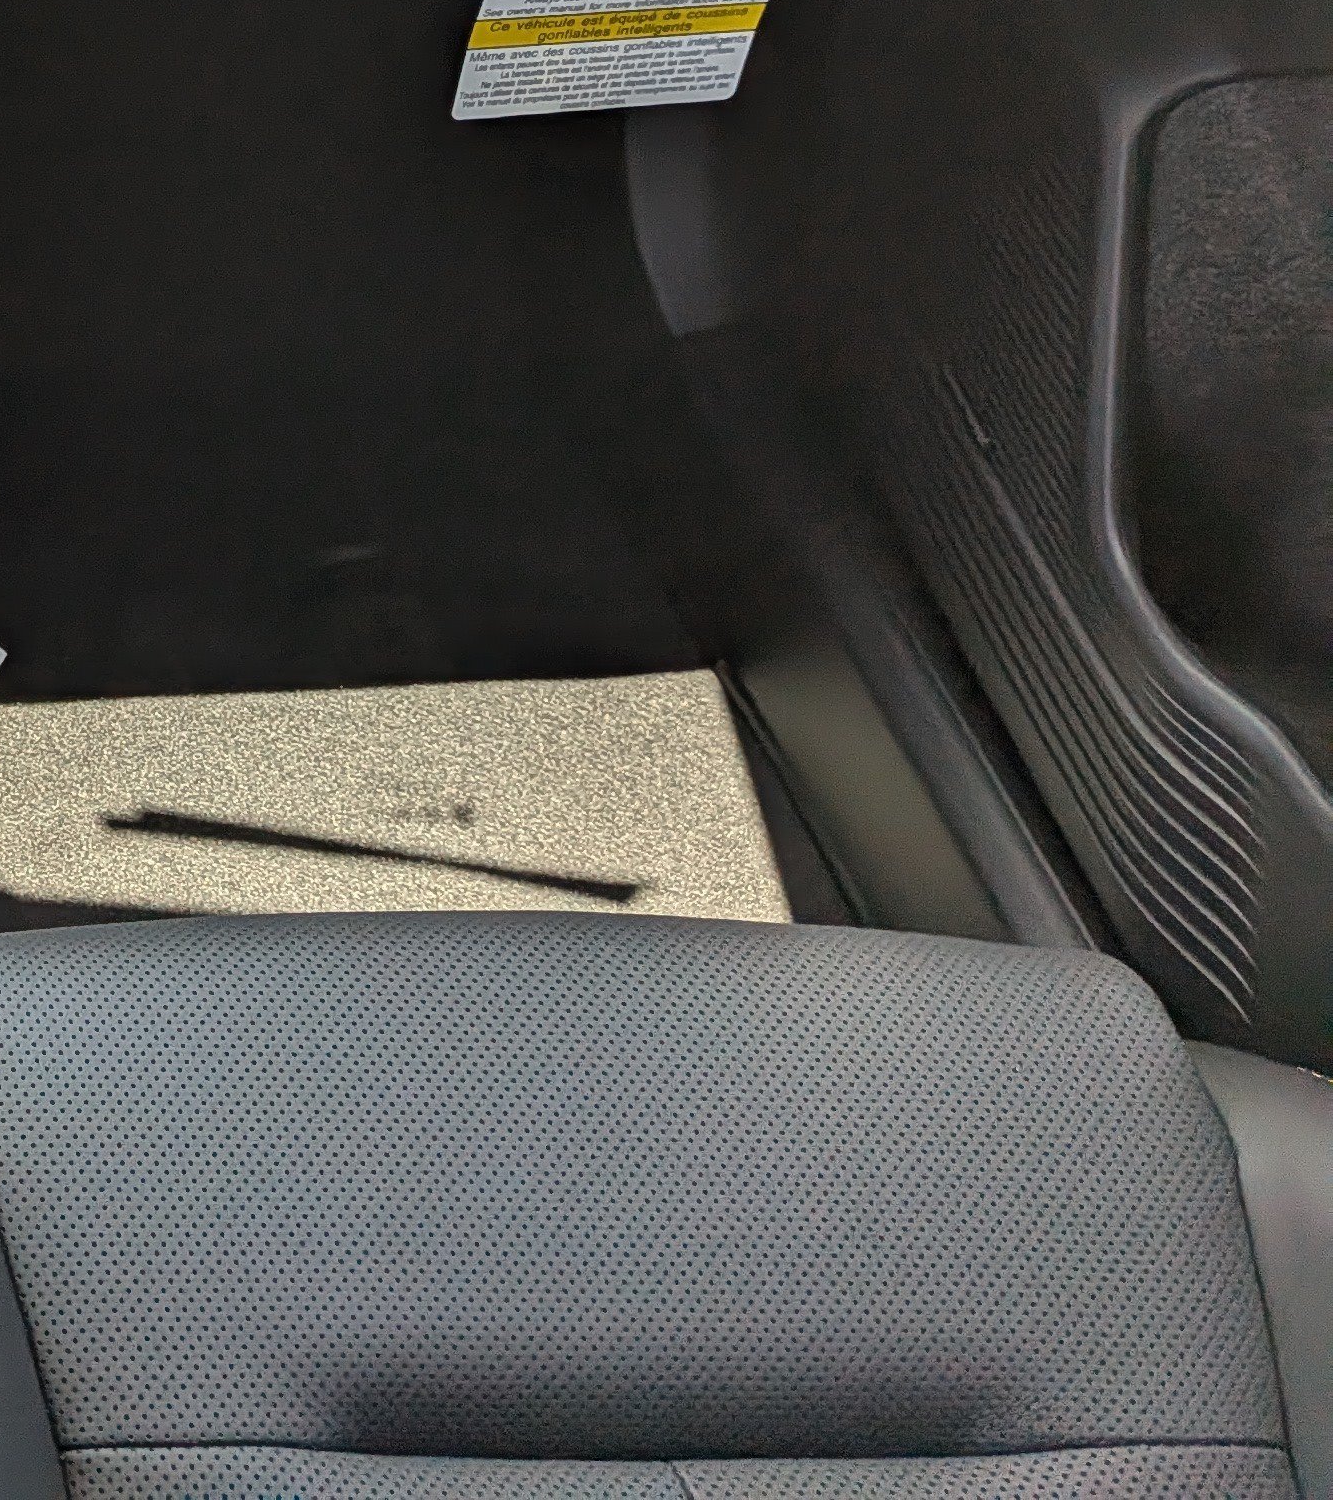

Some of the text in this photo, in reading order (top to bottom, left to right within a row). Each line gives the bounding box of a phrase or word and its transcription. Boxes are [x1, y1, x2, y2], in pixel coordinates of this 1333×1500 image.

[489, 21, 511, 33] Ce
[580, 15, 605, 27] est
[662, 10, 681, 21] de
[686, 7, 749, 20] coussins
[616, 21, 693, 37] intelligents
[469, 51, 507, 63] Même
[510, 50, 539, 60] avec
[542, 46, 565, 57] des
[568, 43, 620, 56] coussins
